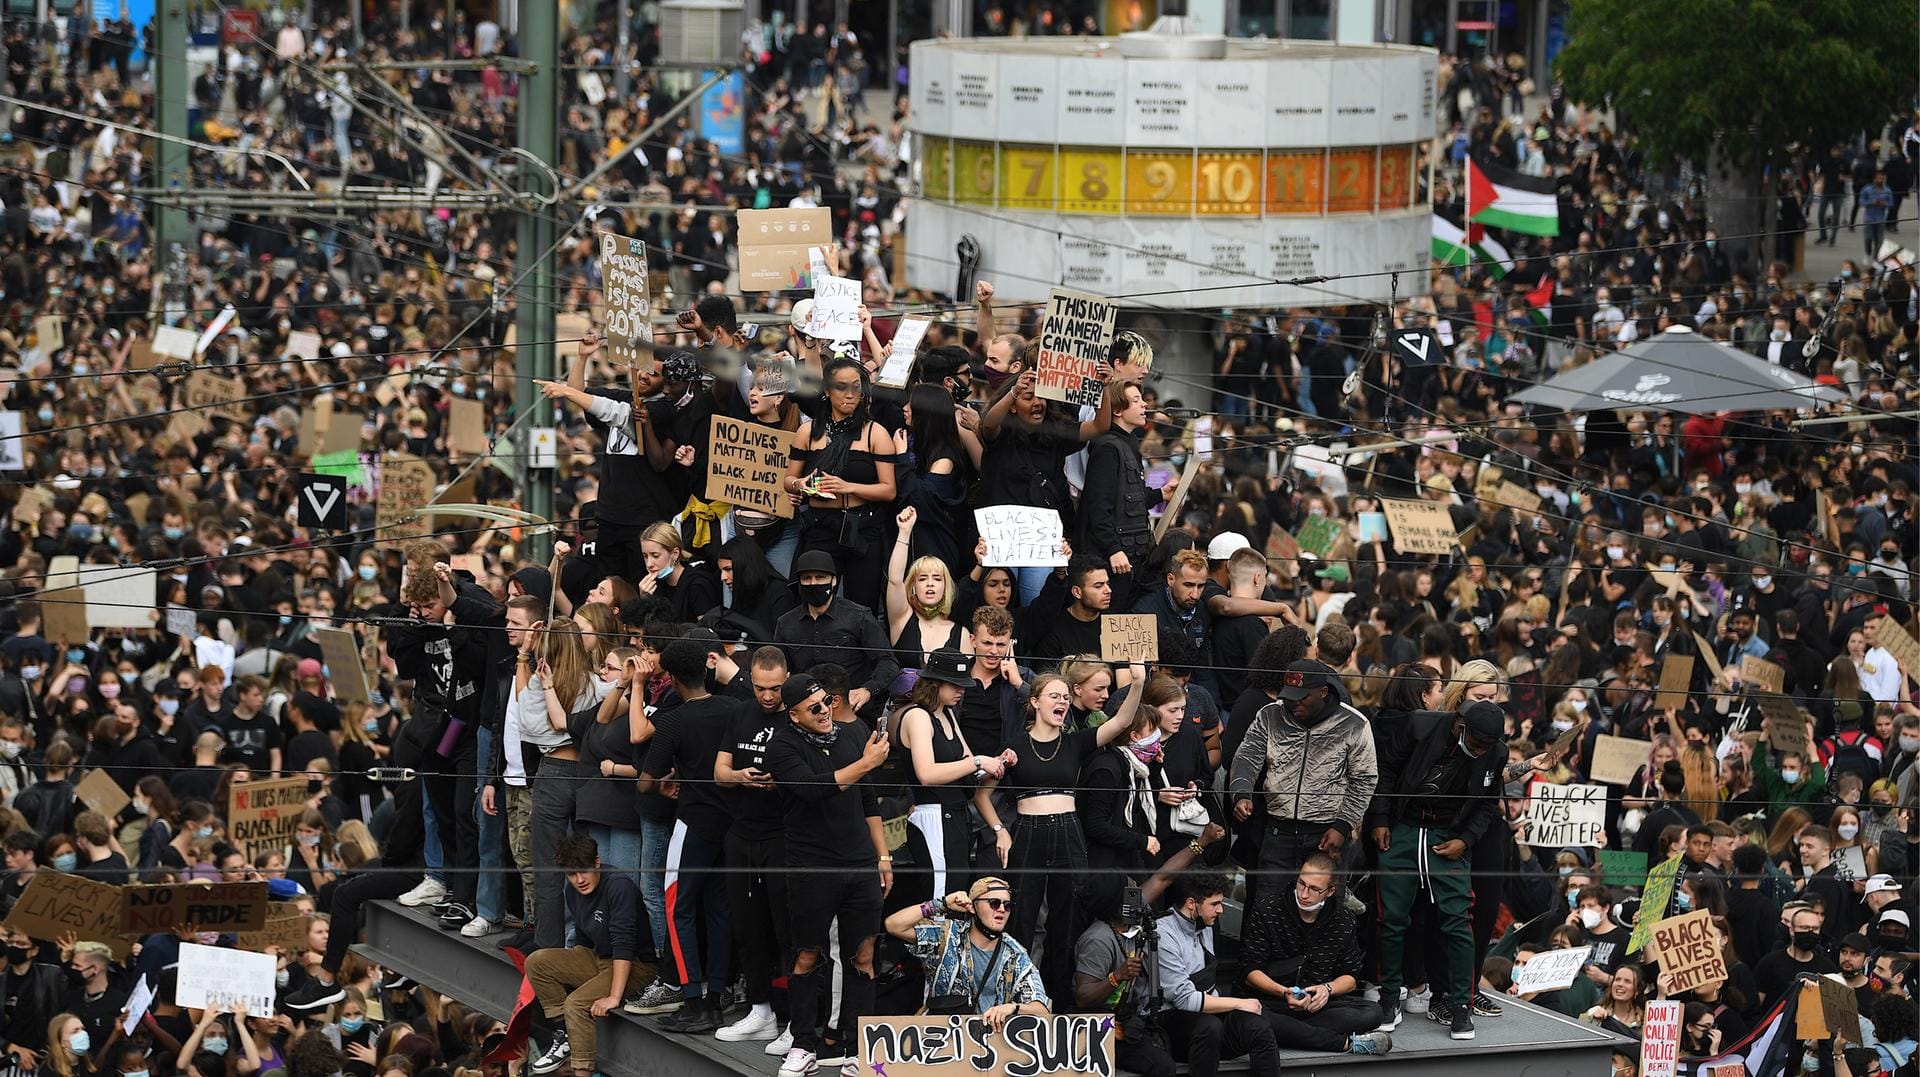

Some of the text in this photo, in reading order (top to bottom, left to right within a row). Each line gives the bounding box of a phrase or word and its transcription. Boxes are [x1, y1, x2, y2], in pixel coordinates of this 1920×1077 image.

[1020, 158, 1046, 196] 7
[1080, 161, 1109, 200] 8
[1144, 161, 1176, 202] 9
[1201, 162, 1254, 202] 10
[1271, 163, 1305, 201] 11
[1328, 160, 1360, 198] 12
[1053, 295, 1119, 323] THIS ISN'T
[1044, 315, 1110, 343] AN AMERI-
[1039, 350, 1080, 374] BLACK
[1042, 334, 1110, 362] CAN THING
[1036, 368, 1081, 391] MATTER
[1065, 388, 1101, 407] WHERE
[716, 421, 779, 450] NO LIVES
[713, 441, 789, 469] MATTER UNTIL
[712, 462, 778, 485] BLACK LIVES
[723, 483, 778, 514] MATTER!
[984, 511, 1043, 526] BLACK
[987, 526, 1048, 543] LIVES
[1108, 616, 1144, 633] BLACK
[1127, 630, 1152, 643] LIVES
[1111, 641, 1156, 659] MATTER
[1525, 801, 1571, 824] LIVES
[235, 818, 274, 841] BLACK
[126, 888, 173, 906] NO
[23, 895, 92, 928] LIVES
[128, 903, 252, 931] NO PRIDE
[1655, 917, 1714, 952] BLACK
[1664, 940, 1716, 971] LIVES
[1667, 959, 1725, 993] MATTER
[1647, 1005, 1677, 1021] DON'T
[863, 1015, 997, 1071] nazis
[1645, 1024, 1665, 1040] CALL
[1644, 1041, 1674, 1061] POLICE
